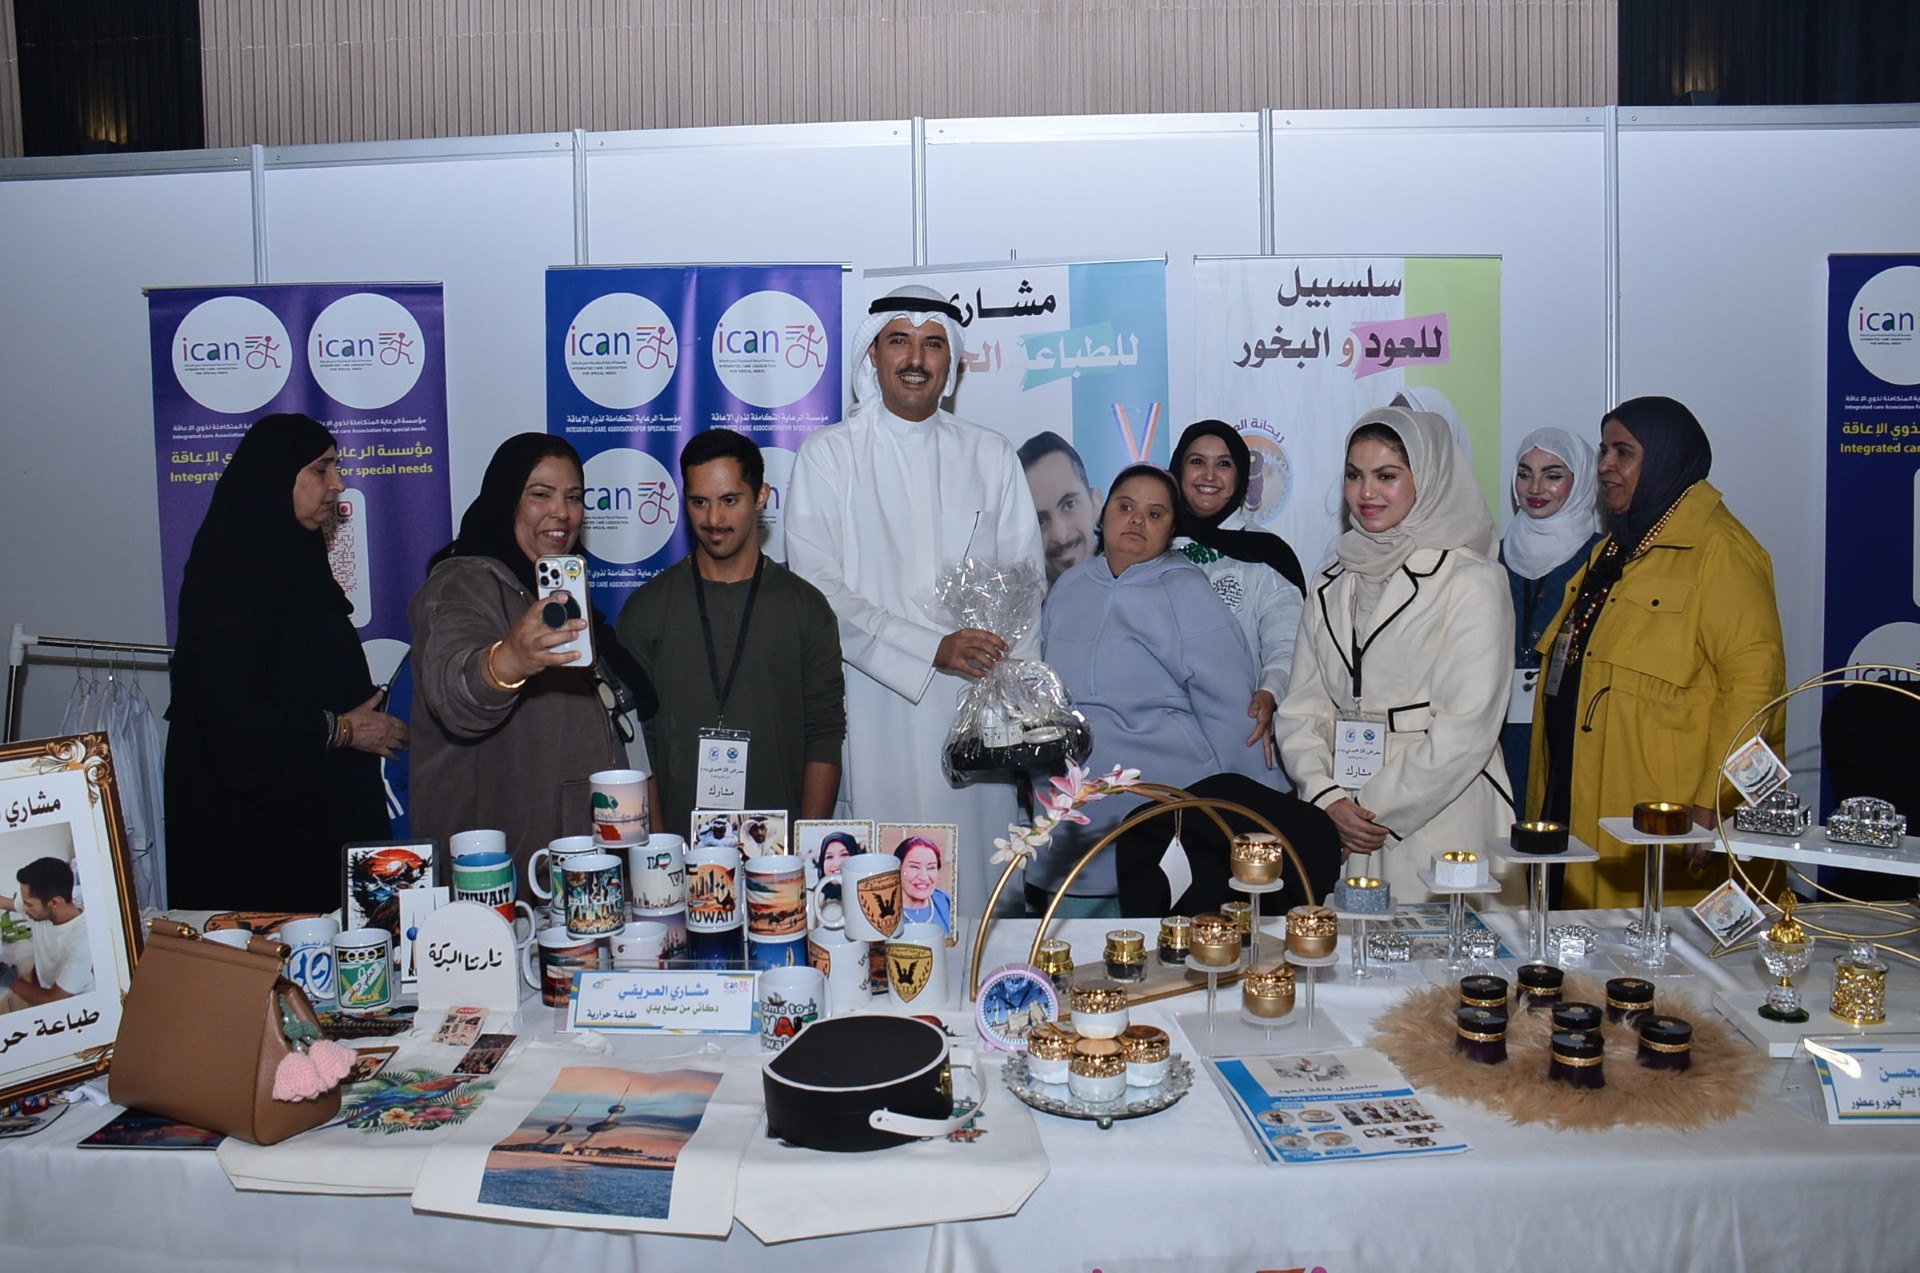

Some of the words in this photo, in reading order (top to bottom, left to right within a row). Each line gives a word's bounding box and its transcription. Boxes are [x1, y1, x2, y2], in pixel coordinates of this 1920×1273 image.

[1277, 264, 1402, 308] سلسبيل
[1859, 306, 1914, 332] ican
[317, 332, 375, 358] ican
[571, 325, 631, 356] ican
[718, 322, 780, 354] ican
[1364, 324, 1443, 368] للعود
[183, 336, 240, 362] ican
[1017, 332, 1140, 379] للطباعة
[1232, 324, 1331, 370] البخور
[1335, 336, 1355, 368] و
[1250, 417, 1285, 445] ريحانة
[1842, 421, 1889, 438] الإعاقة
[377, 441, 433, 458] مؤسسة
[1840, 442, 1902, 456] Integrated
[171, 450, 219, 466] الإعاقة
[356, 464, 396, 478] special
[398, 463, 433, 474] needs
[583, 484, 632, 511] can
[1345, 765, 1372, 778] مشارك
[708, 784, 735, 798] مشارك
[5, 790, 62, 828] مشاري
[688, 910, 734, 924] KUWAIT
[428, 941, 462, 972] البركة
[669, 982, 709, 1001] مشاري
[723, 980, 739, 989] ican
[586, 1009, 611, 1021] حرارية
[613, 1008, 638, 1020] طباعة
[645, 1003, 661, 1015] يدي
[662, 1002, 678, 1015] صنع
[680, 1004, 691, 1014] من
[35, 1008, 101, 1039] طباعة
[1897, 1085, 1916, 1098] يدي
[1851, 1096, 1880, 1110] وعطور
[1882, 1096, 1902, 1110] بخور
